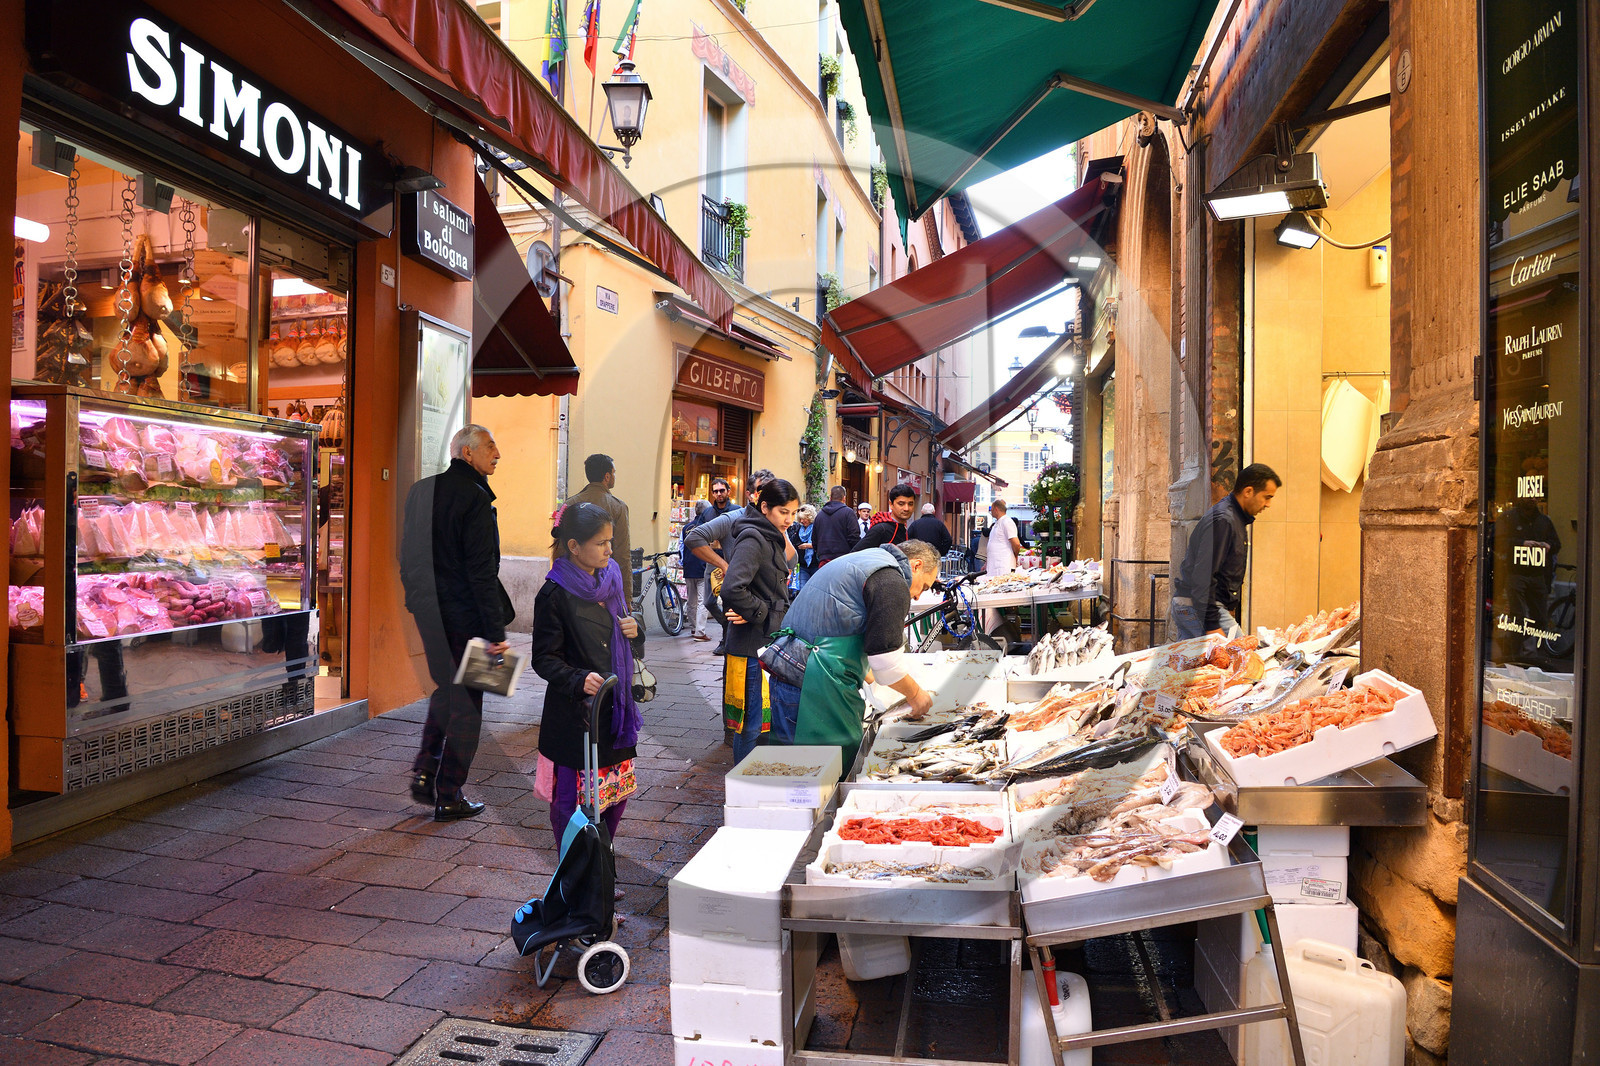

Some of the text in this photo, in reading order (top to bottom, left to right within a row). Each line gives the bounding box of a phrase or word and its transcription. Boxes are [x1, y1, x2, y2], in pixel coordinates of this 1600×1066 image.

[1502, 10, 1562, 75] GIORGIO ARMANI
[126, 18, 362, 211] SIMONI
[1501, 86, 1566, 142] ISSEY MIYAKE
[1503, 159, 1564, 209] ELIE SAAB
[433, 200, 469, 235] salumi
[1518, 193, 1547, 215] PARFUMS
[423, 229, 468, 271] Bologna
[441, 224, 453, 245] di
[1510, 253, 1557, 287] Cartier
[1504, 322, 1563, 356] RALPH LAUREN
[1521, 348, 1543, 361] PARFUMS
[690, 361, 758, 398] GILBERTO
[1517, 475, 1545, 498] DIESEL
[1513, 545, 1546, 567] FENDI
[1497, 613, 1562, 649] Salvatore Ferragamo
